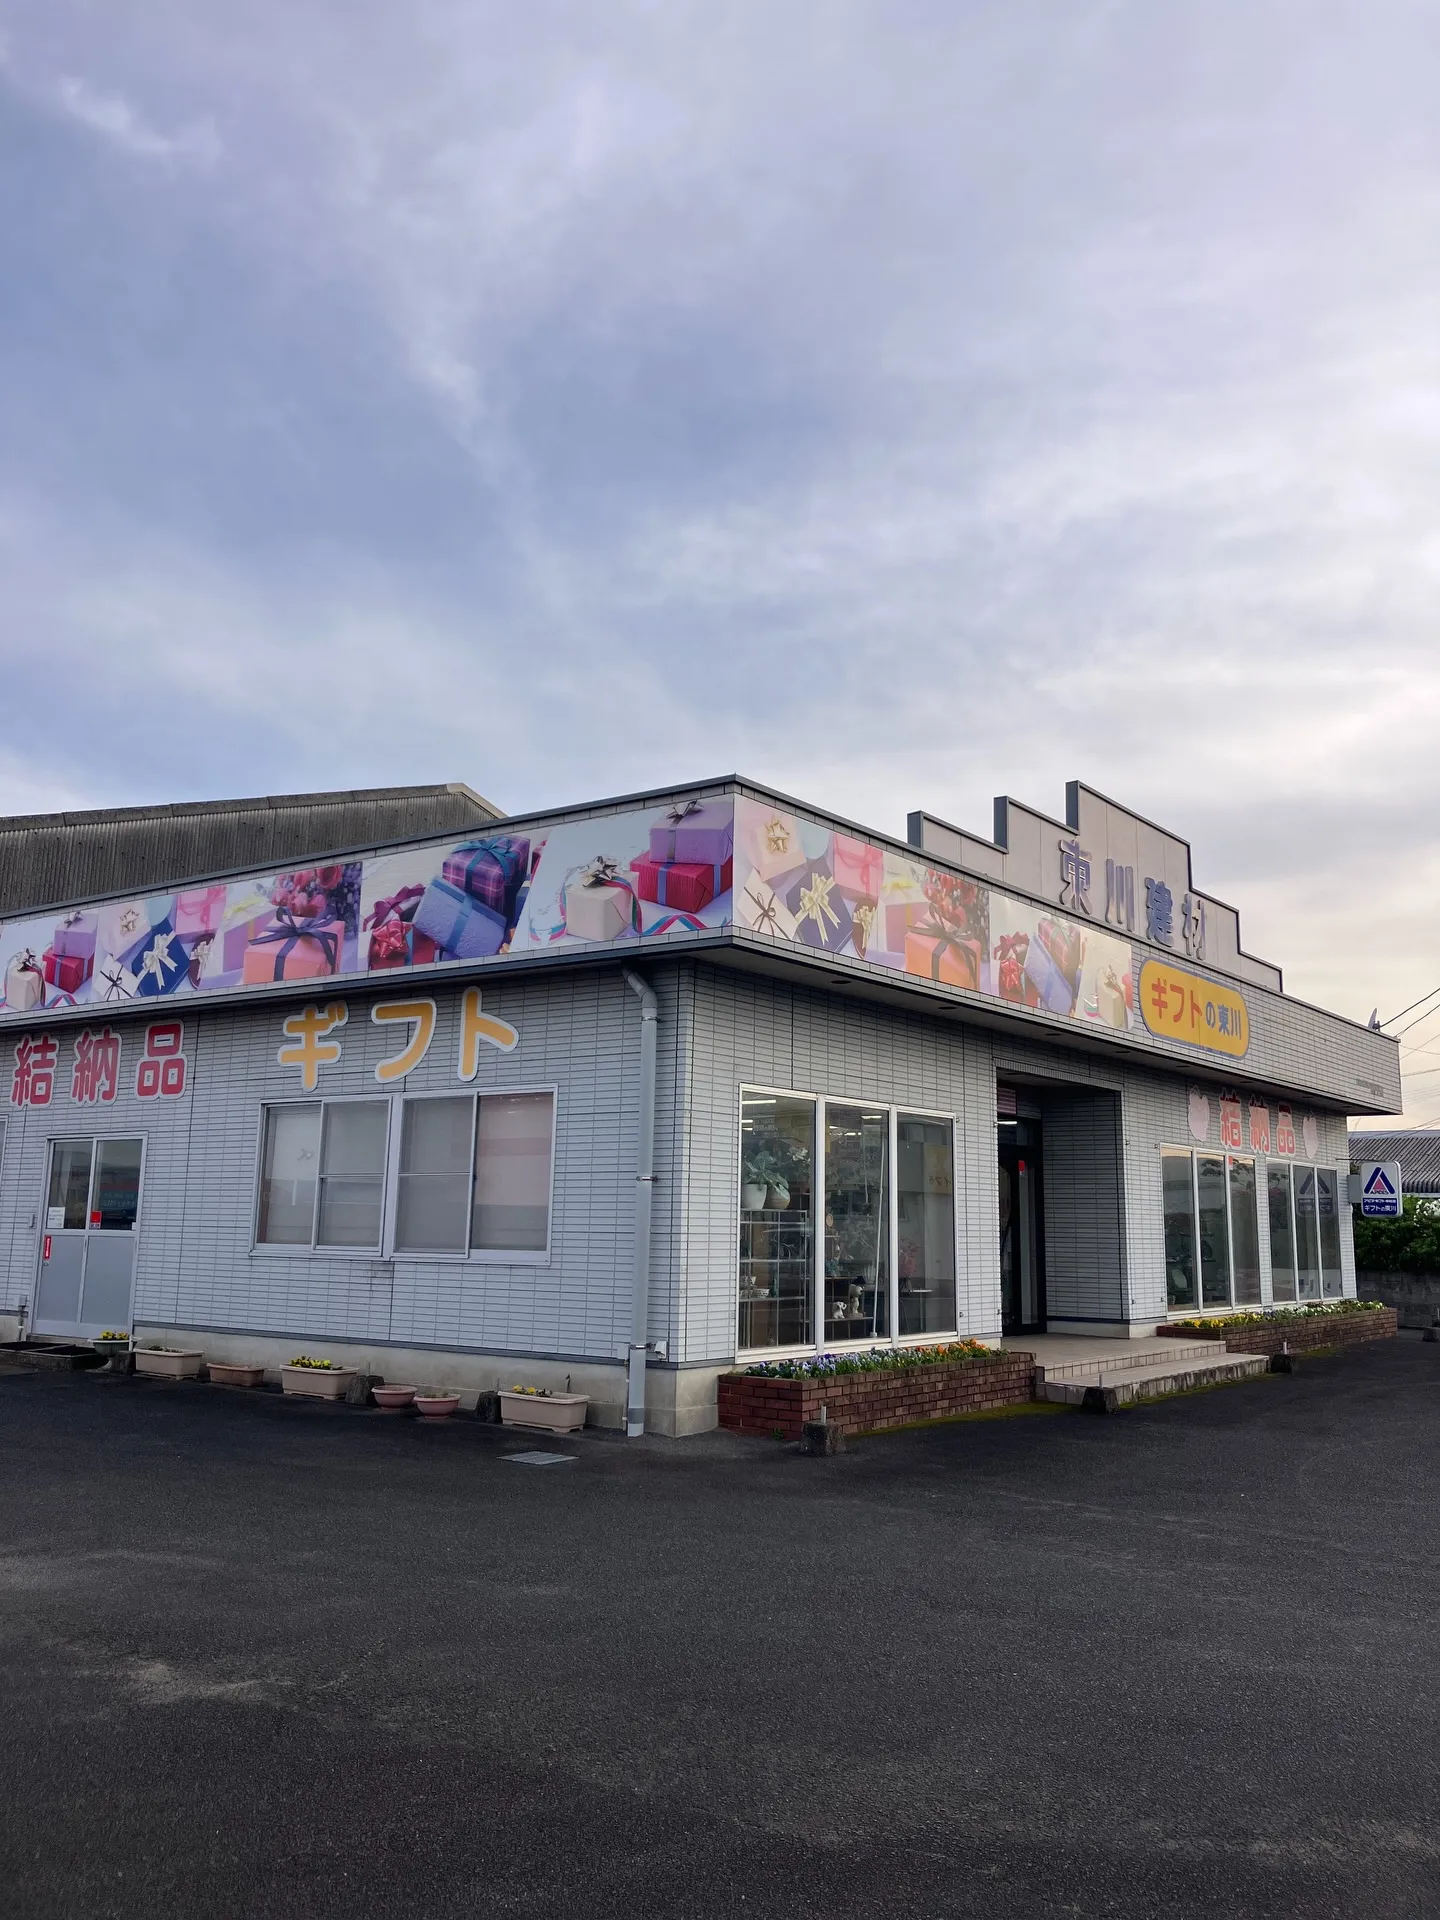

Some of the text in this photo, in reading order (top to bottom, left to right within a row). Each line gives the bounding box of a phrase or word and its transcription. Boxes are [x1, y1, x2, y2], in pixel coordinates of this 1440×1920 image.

[1058, 836, 1207, 961] 東川建材
[279, 987, 518, 1091] ギフト
[1151, 977, 1242, 1041] ギフトの東川
[11, 1020, 186, 1107] 結納品
[1220, 1088, 1296, 1157] 結納品
